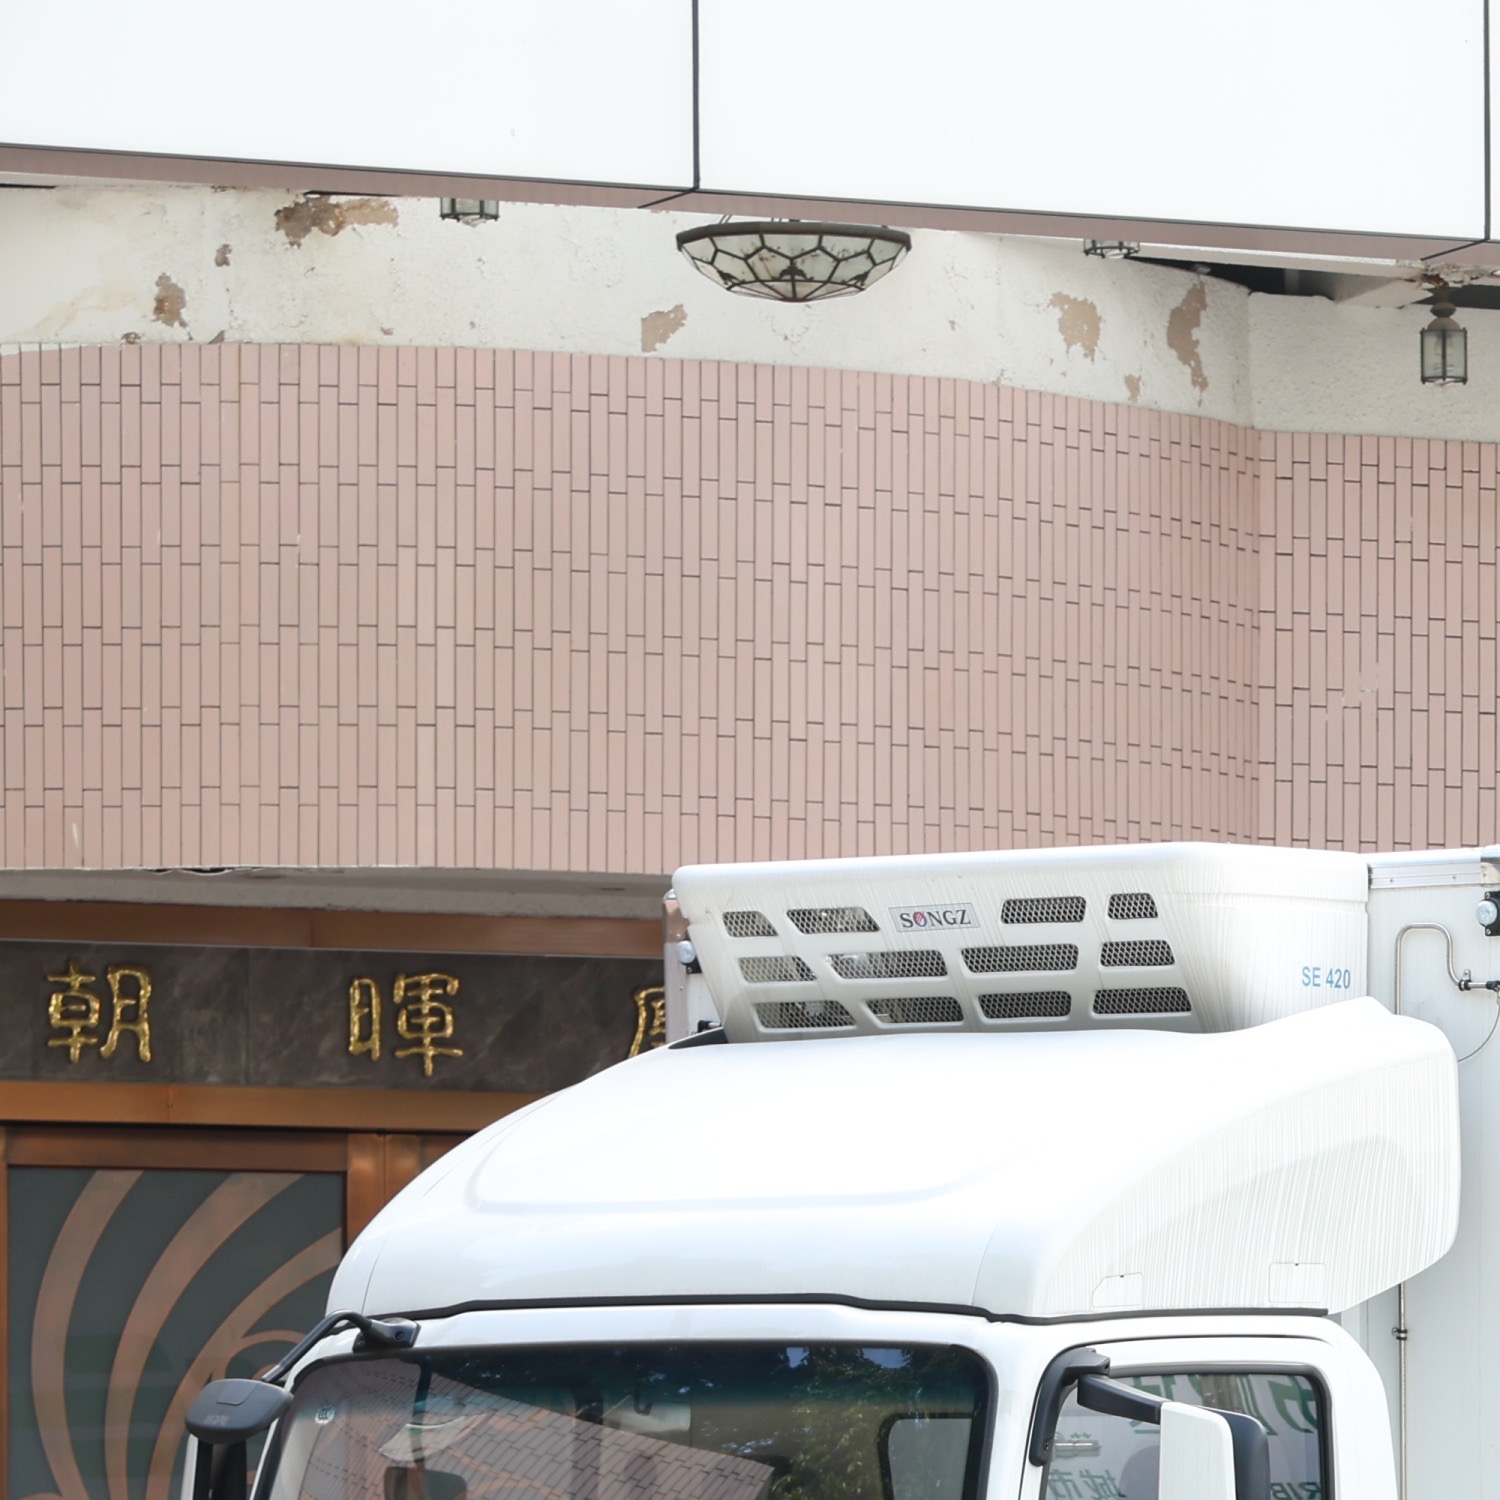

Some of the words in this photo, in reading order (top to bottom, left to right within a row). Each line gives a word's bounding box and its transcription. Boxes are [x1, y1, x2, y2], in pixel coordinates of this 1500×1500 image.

[900, 908, 972, 930] SONGZ
[1301, 965, 1322, 990] SE
[1325, 965, 1352, 991] 420
